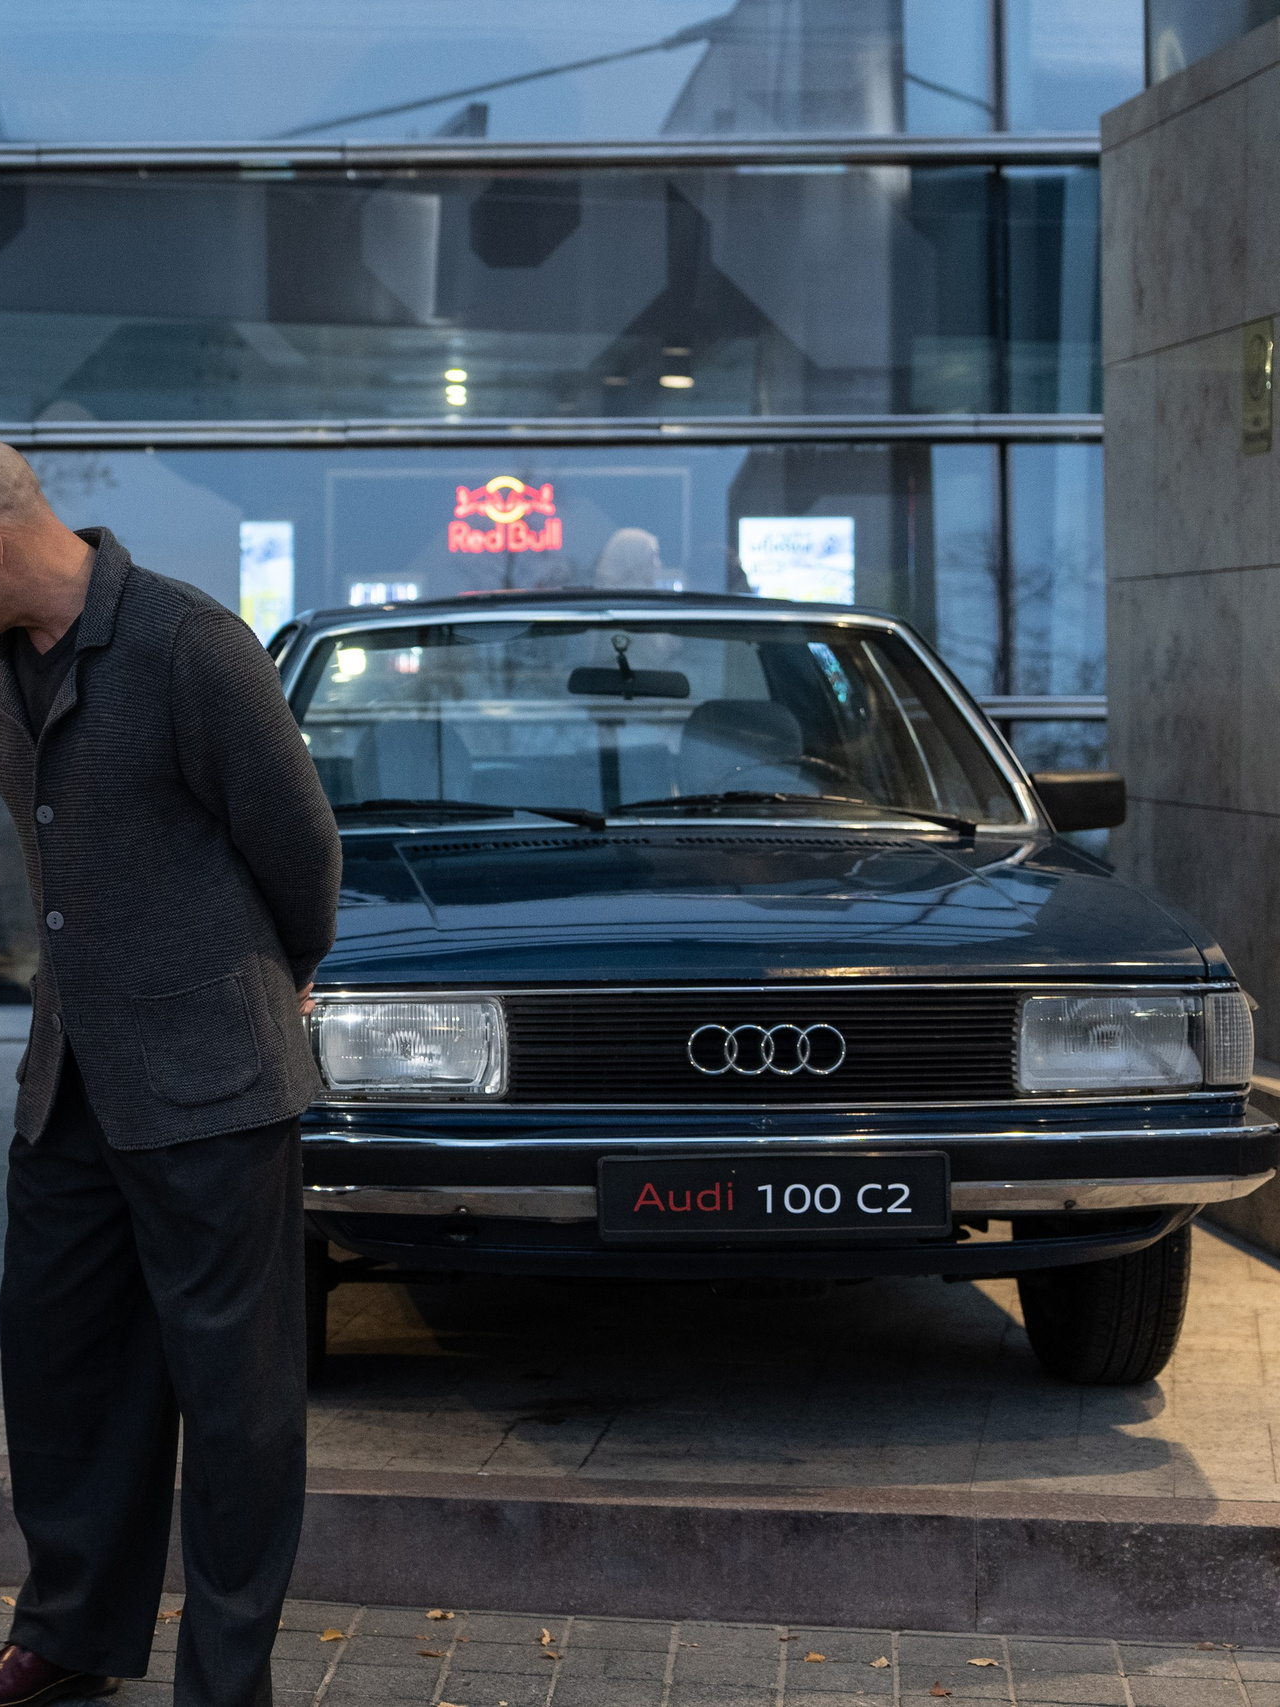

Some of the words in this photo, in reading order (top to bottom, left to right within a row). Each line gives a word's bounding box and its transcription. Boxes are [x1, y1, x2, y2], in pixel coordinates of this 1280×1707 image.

[448, 519, 505, 554] Red
[506, 517, 563, 553] Bull
[633, 1181, 734, 1212] Audi
[757, 1183, 841, 1214] 100
[856, 1183, 912, 1214] C2
